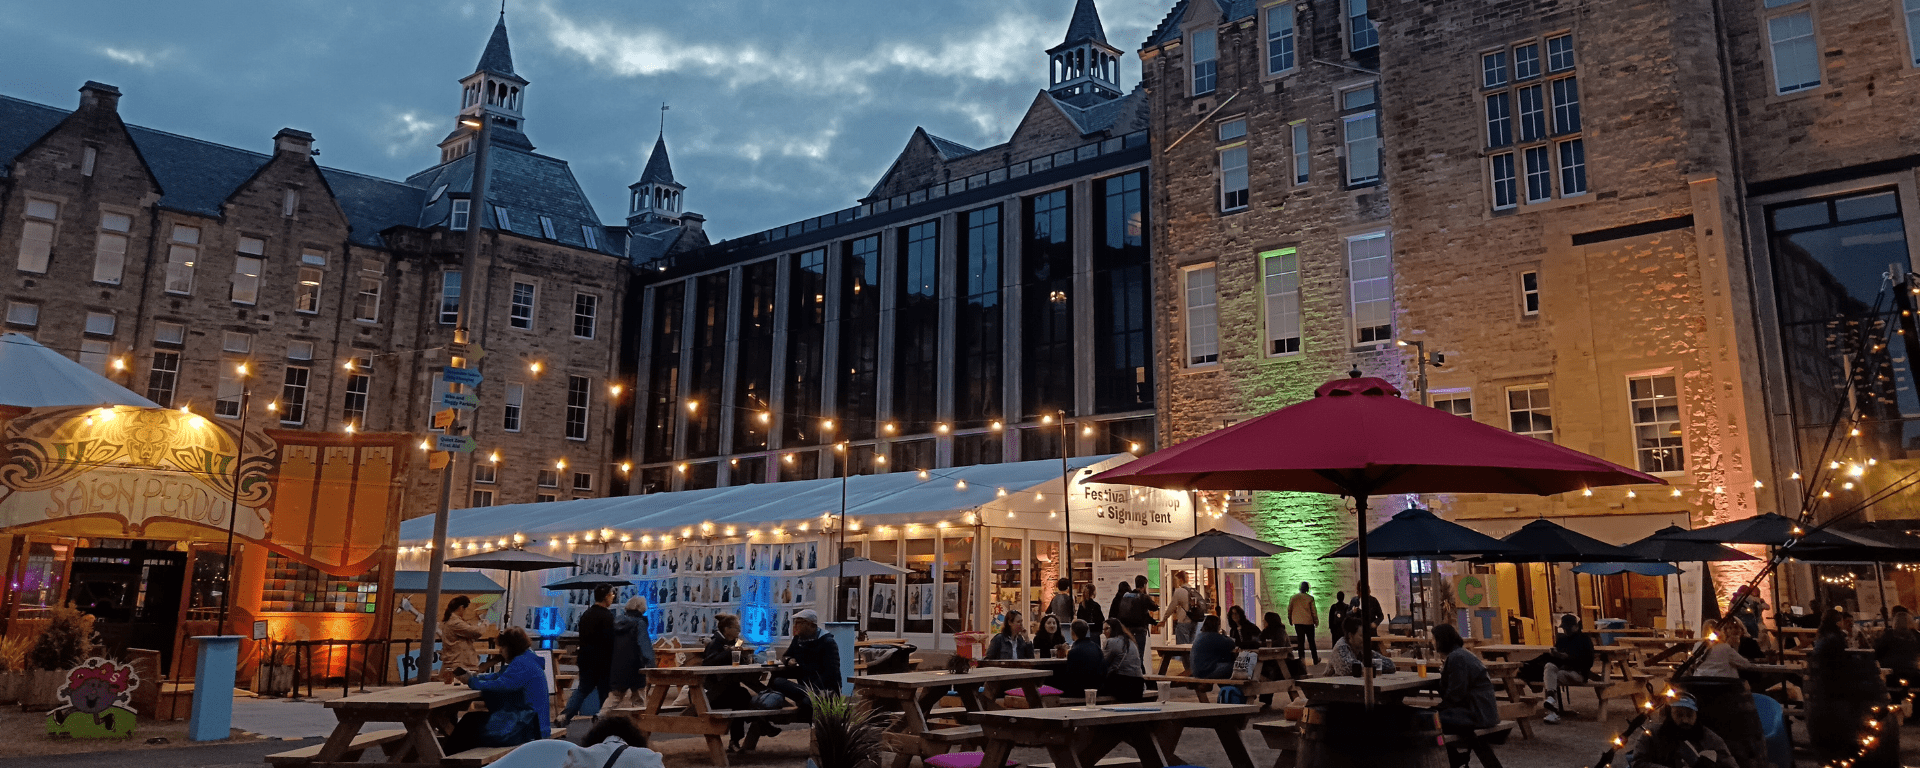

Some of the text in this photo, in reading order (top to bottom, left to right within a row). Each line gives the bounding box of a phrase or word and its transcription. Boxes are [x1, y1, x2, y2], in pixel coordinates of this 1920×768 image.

[459, 400, 476, 408] Parking
[45, 478, 226, 525] SALON PERDU
[1085, 487, 1128, 504] Festival
[1096, 506, 1172, 526] & Signing Tent
